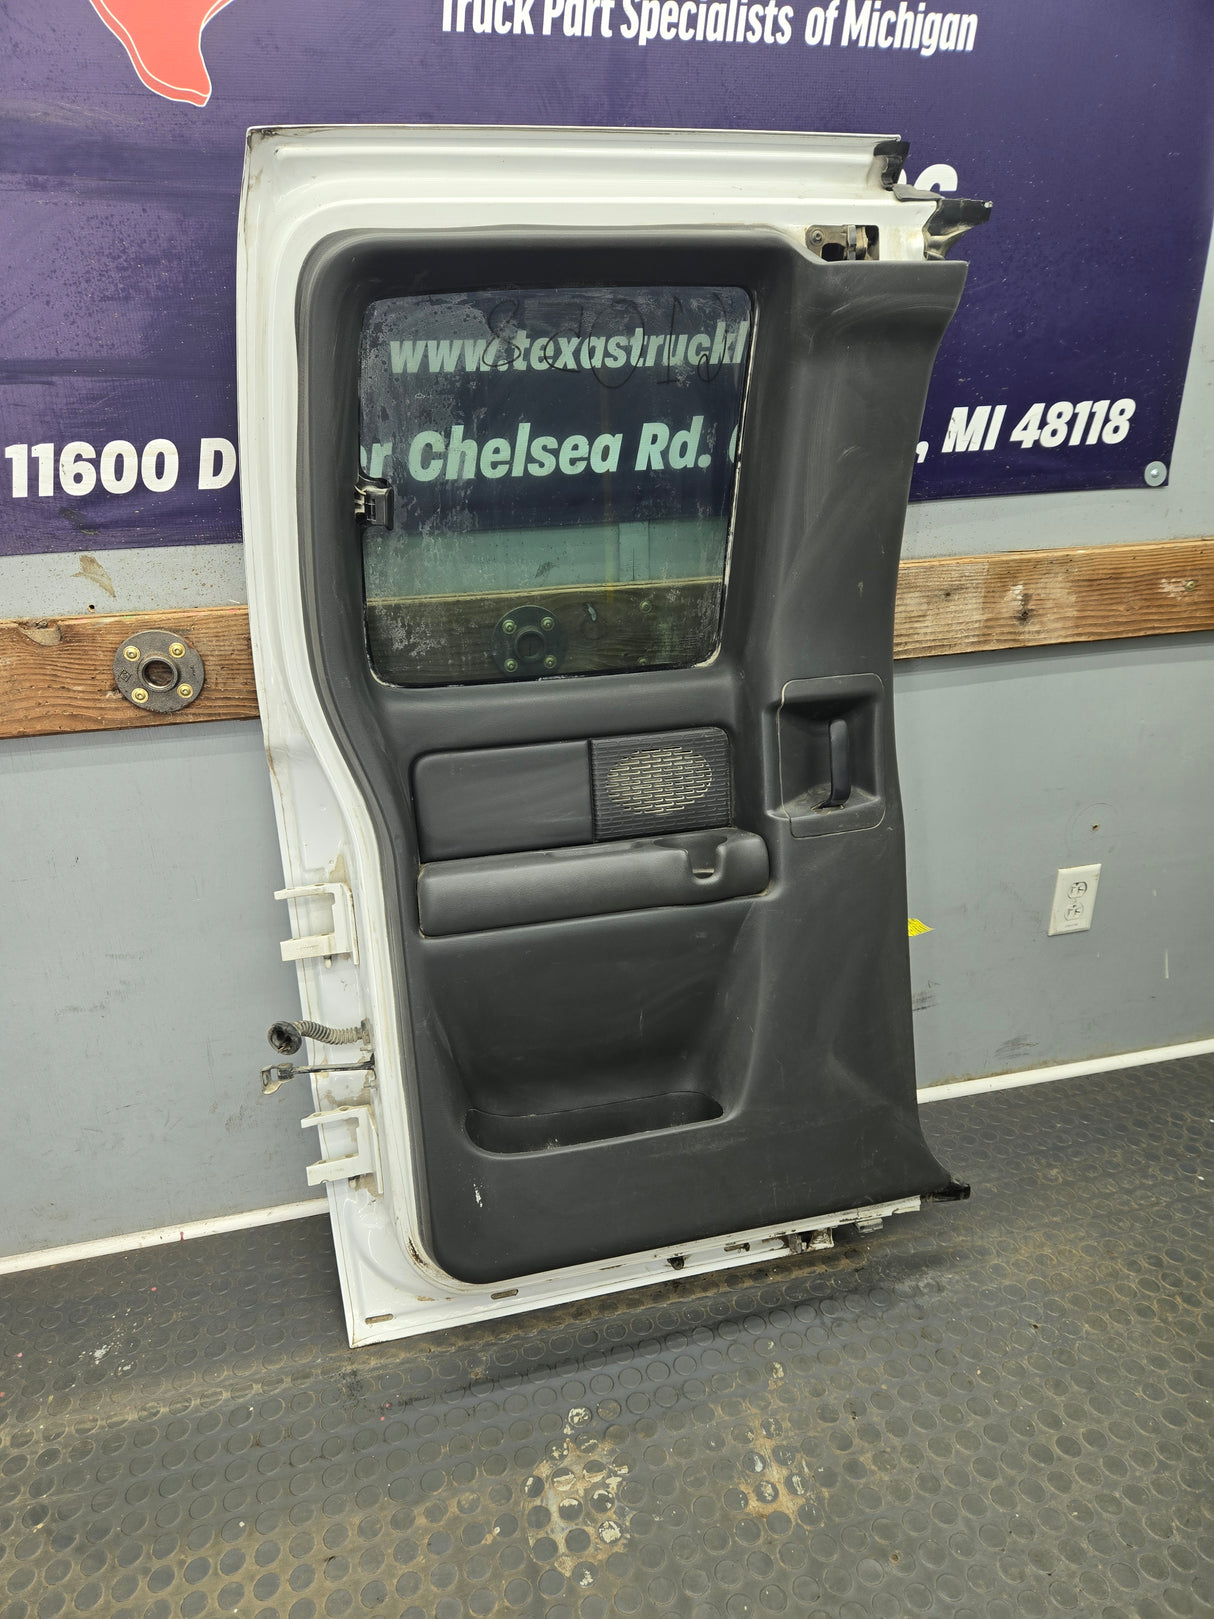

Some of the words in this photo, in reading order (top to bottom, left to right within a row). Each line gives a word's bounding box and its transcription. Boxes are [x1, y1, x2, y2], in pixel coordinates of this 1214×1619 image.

[542, 0, 616, 38] Part
[619, 0, 794, 46] Specialists
[804, 0, 841, 46] of
[840, 0, 979, 57] Michigan
[4, 438, 179, 499] 11600
[408, 422, 624, 482] Chelsea
[634, 415, 712, 471] Rd.
[941, 404, 1007, 453] MI
[1009, 398, 1136, 449] 48118
